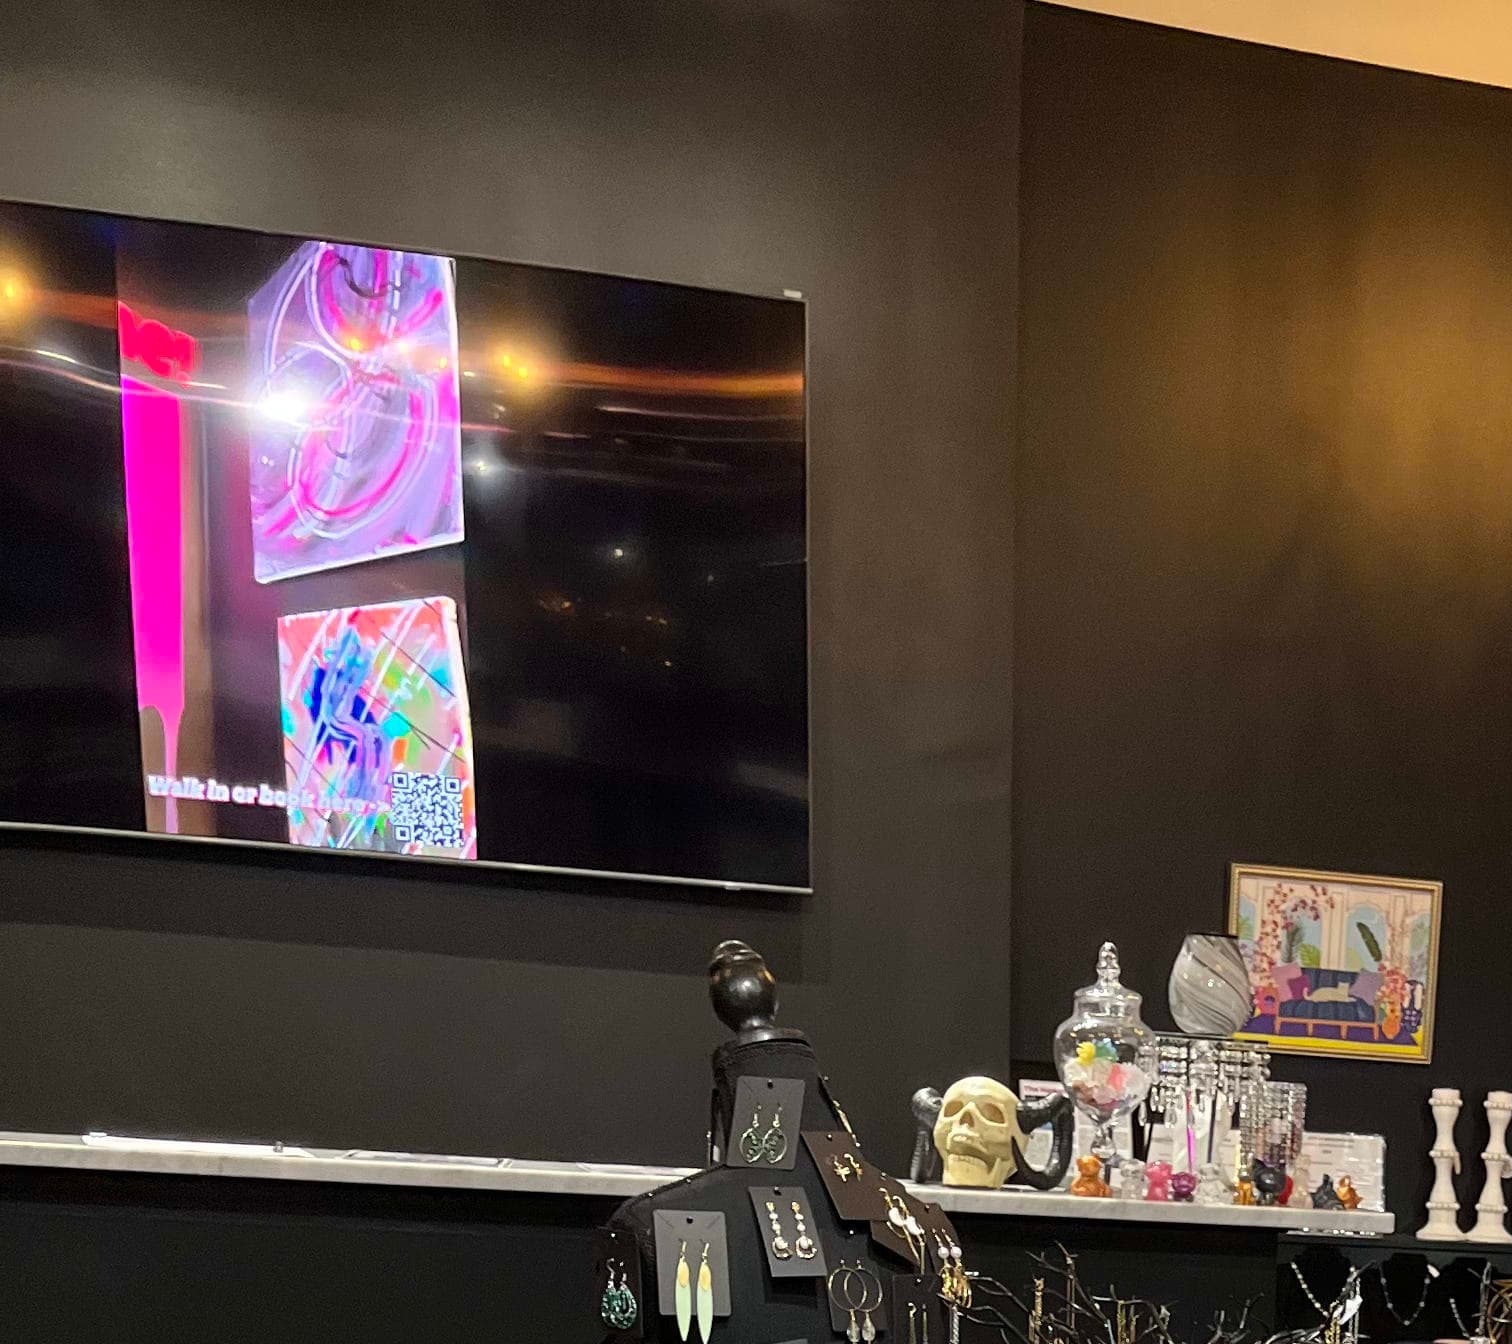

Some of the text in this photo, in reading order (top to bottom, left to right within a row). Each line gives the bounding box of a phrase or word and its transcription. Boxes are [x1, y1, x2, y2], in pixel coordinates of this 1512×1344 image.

[148, 775, 205, 799] Walk
[206, 779, 230, 803] in
[232, 783, 258, 805] or
[259, 783, 314, 809] book
